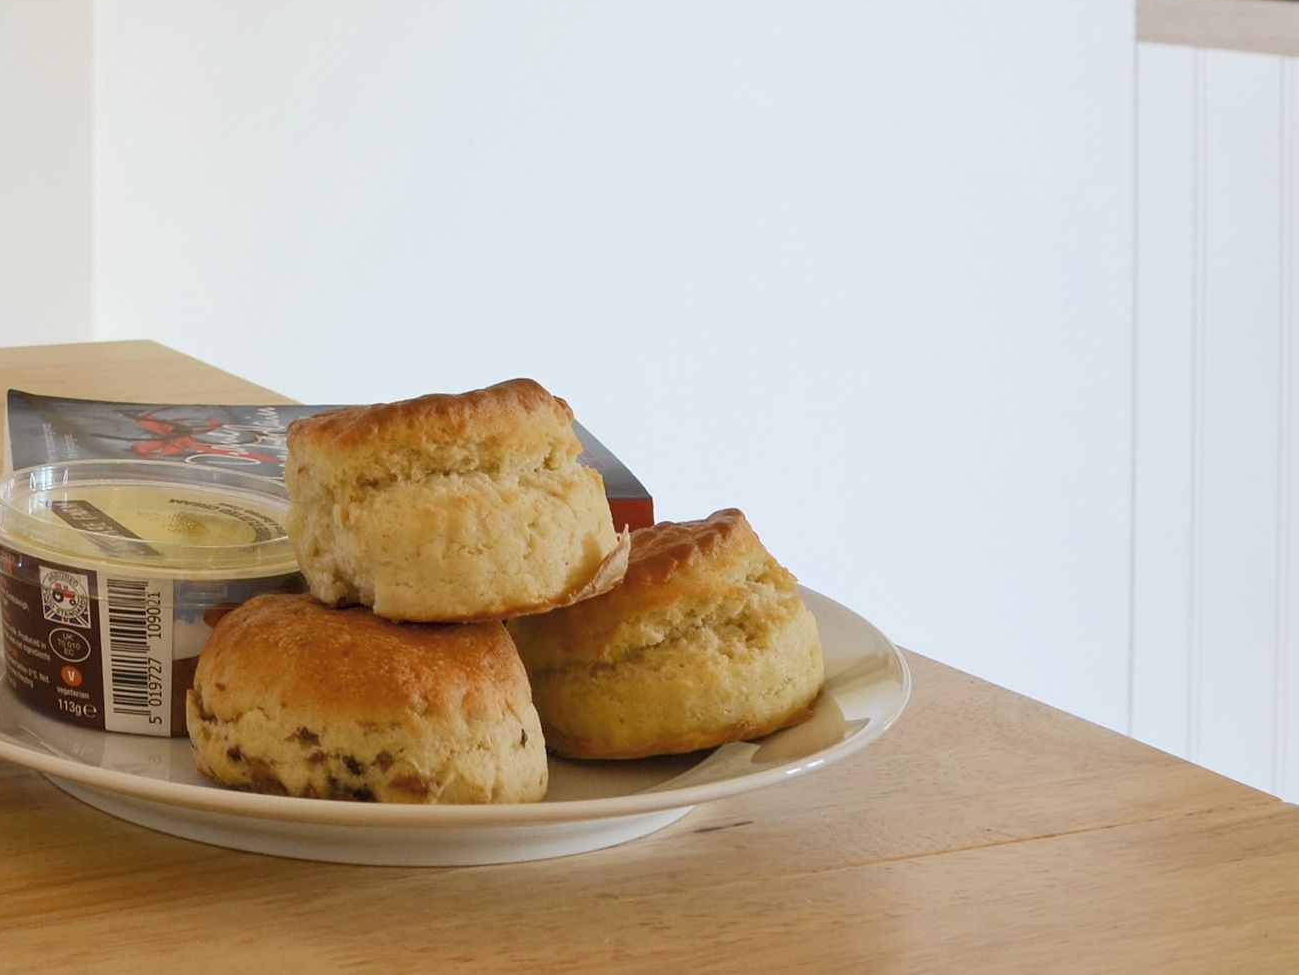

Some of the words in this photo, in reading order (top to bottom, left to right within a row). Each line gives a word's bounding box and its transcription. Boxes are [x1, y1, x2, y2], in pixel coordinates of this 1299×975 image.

[146, 591, 162, 640] 109021
[67, 669, 75, 682] V
[147, 657, 163, 708] 019727
[56, 686, 90, 699] vegetarian
[148, 716, 163, 725] 5
